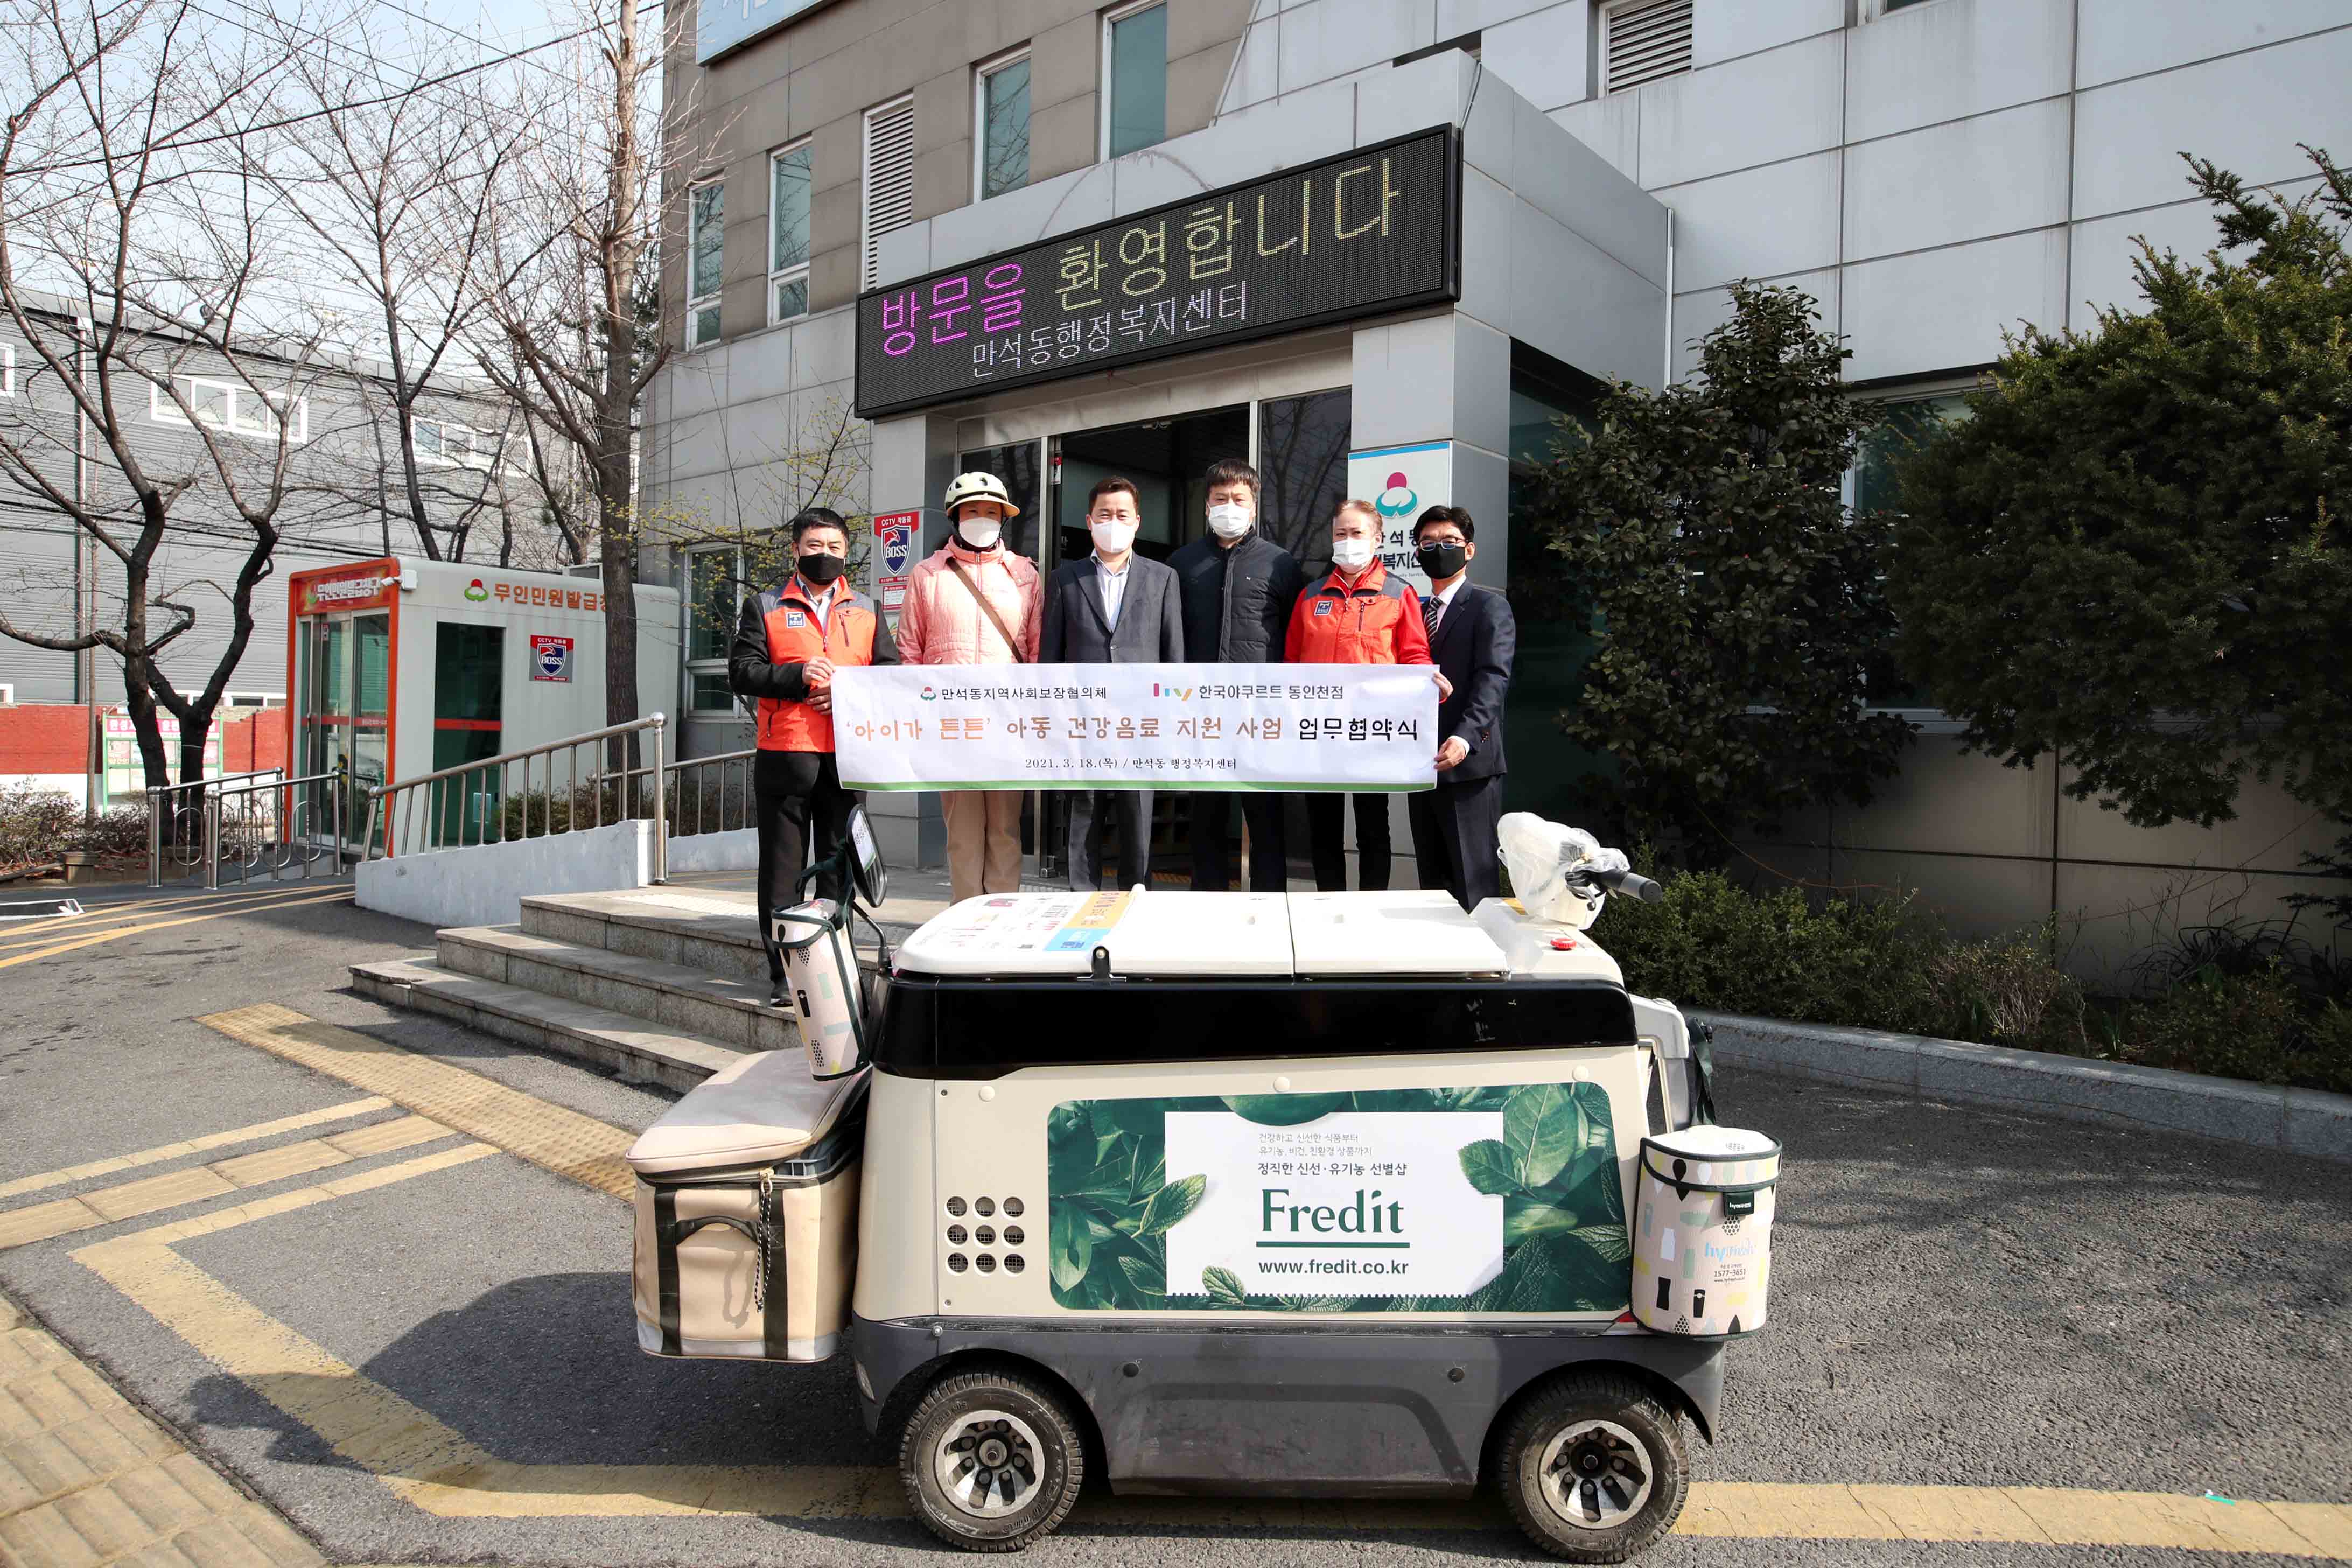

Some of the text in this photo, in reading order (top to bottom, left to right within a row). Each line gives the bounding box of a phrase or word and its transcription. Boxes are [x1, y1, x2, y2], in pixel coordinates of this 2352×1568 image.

[881, 157, 1399, 356] 방문을 환영합니다
[972, 280, 1247, 377] 만석동행정복지센터
[881, 518, 895, 526] CCTV
[885, 545, 907, 558] BOSS
[541, 656, 562, 665] BOSS
[942, 687, 1107, 700] 만석동지역사회보장협의체
[1199, 685, 1282, 699] 한국야쿠르트
[1289, 685, 1343, 699] 동인천점
[1007, 716, 1051, 739] 아동
[1068, 716, 1159, 739] 건강음료
[1177, 717, 1221, 739] 지원
[1236, 717, 1282, 739] 사업
[1299, 717, 1418, 741] 업무협약식
[1025, 758, 1059, 768] 2021.
[1133, 758, 1165, 769] 만석동
[1171, 758, 1237, 769] 행정복지센터
[1259, 1133, 1359, 1143] 건강하고 신선한 식품부터
[1310, 1146, 1334, 1156] 친환경
[1338, 1146, 1372, 1156] 상품까지
[1258, 1163, 1293, 1175] 정직한
[1370, 1163, 1407, 1176] 선별샵
[1262, 1188, 1405, 1233] Fredit
[1258, 1259, 1409, 1275] www.fredit.co.kr
[1714, 1269, 1746, 1277] 1577-3651
